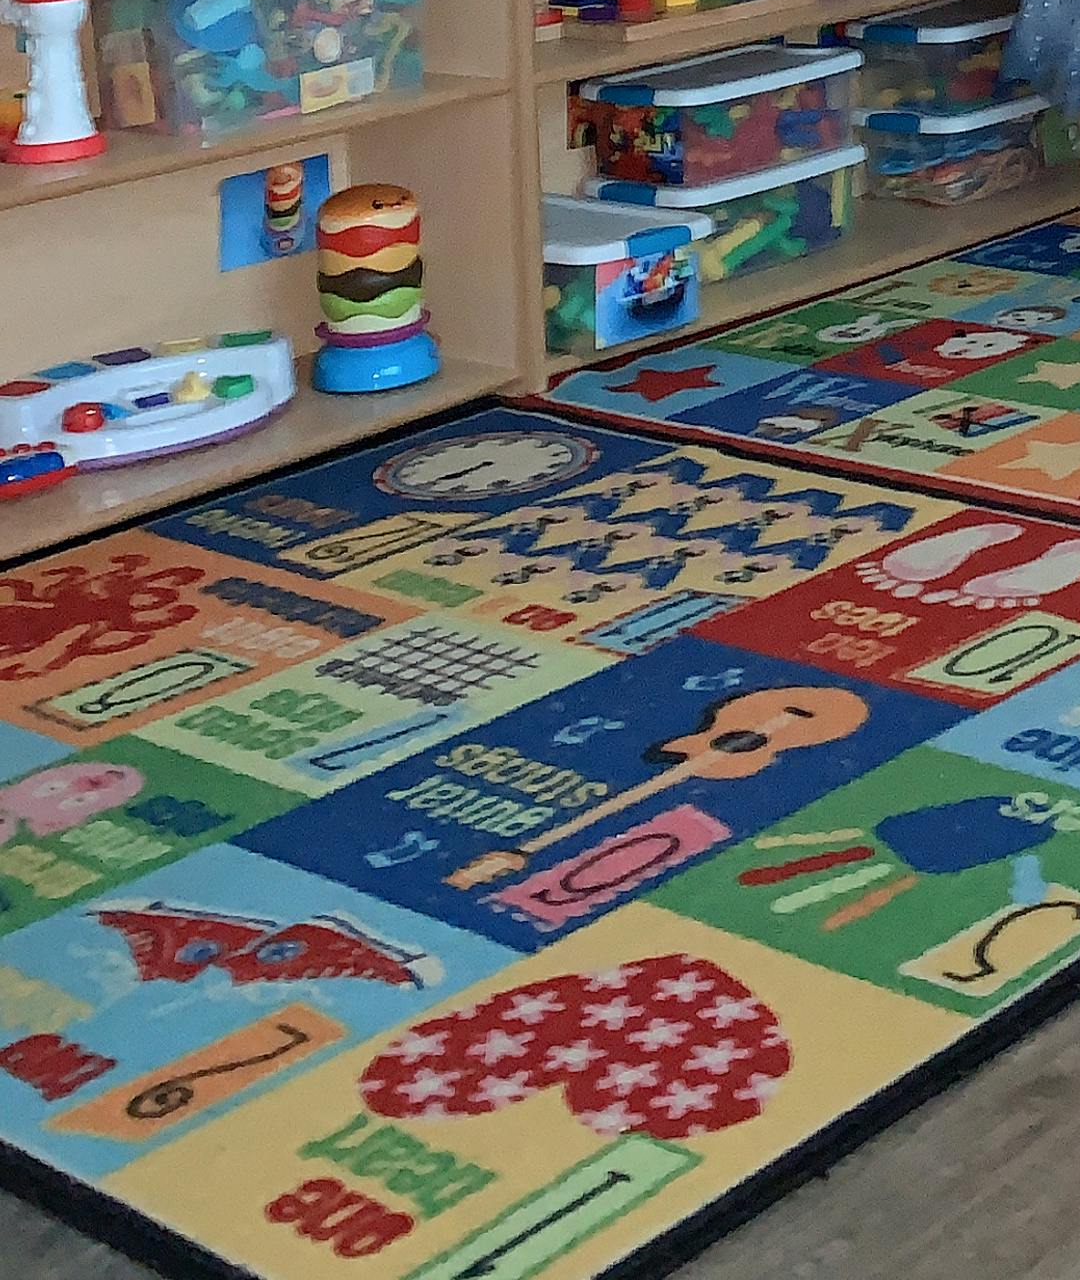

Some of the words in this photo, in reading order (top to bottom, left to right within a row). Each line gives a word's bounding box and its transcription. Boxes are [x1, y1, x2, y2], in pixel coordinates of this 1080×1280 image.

[806, 633, 897, 666] ten
[809, 599, 918, 636] toes
[388, 774, 555, 839] guitar
[432, 744, 610, 808] strings
[126, 1024, 308, 1118] 2
[300, 1114, 493, 1215] heart
[263, 1177, 416, 1258] one
